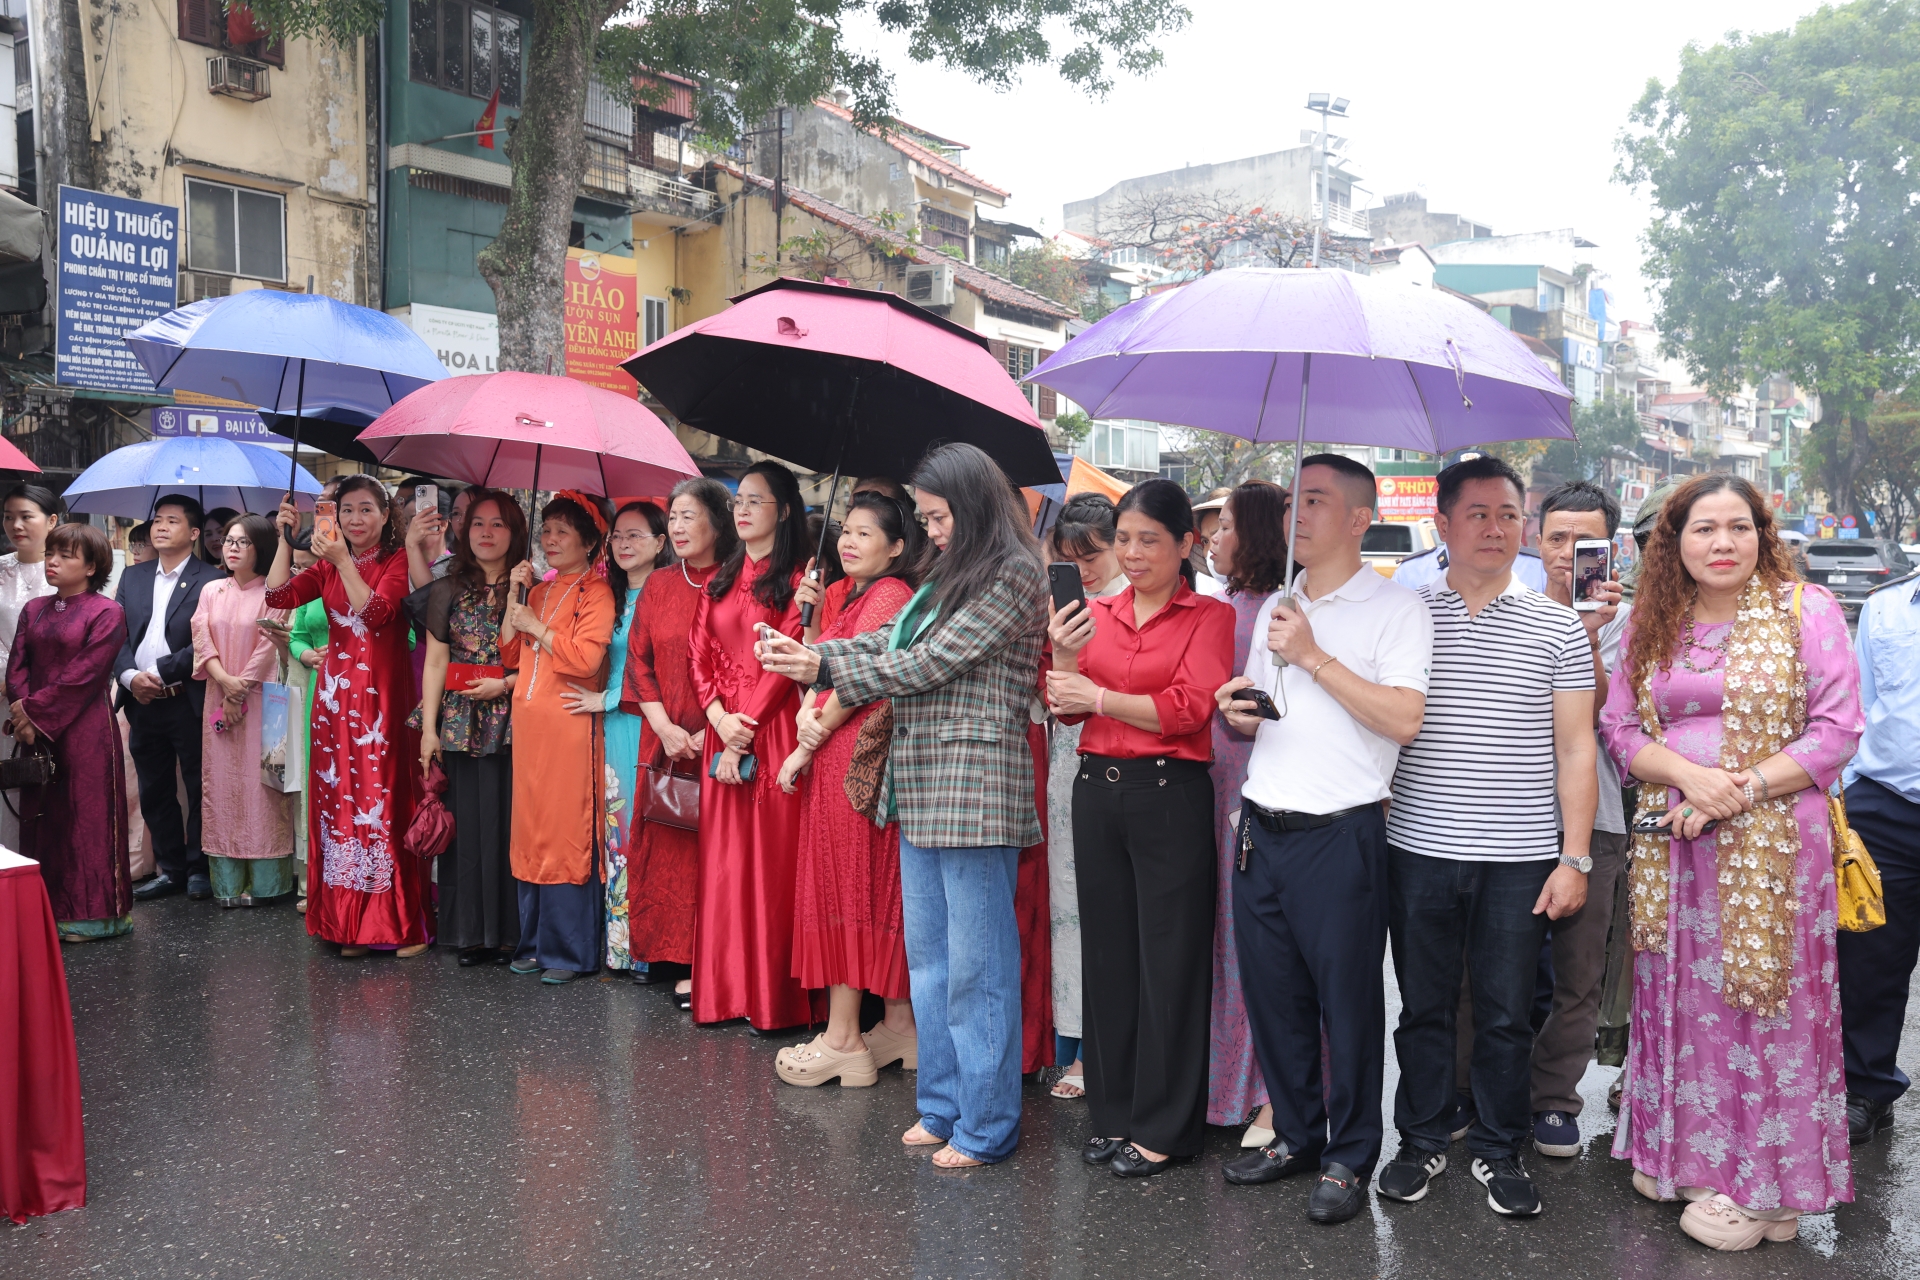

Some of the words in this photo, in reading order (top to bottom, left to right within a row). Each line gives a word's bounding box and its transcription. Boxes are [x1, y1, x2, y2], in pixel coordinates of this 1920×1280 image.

[65, 201, 109, 231] HIỆU
[115, 211, 174, 241] THUỐC
[71, 232, 136, 264] QUẢNG
[141, 245, 169, 272] LỢI
[64, 262, 87, 276] PHONG
[108, 268, 118, 282] TRỊ
[120, 270, 124, 280] Y
[125, 271, 139, 284] HỌC
[64, 288, 88, 298] LƯƠNG
[95, 291, 107, 300] GIA
[142, 298, 154, 306] DUY
[155, 300, 171, 308] NINH
[101, 284, 115, 293] CHỦ
[65, 308, 80, 319] VIÊM
[116, 316, 129, 326] MỤN
[129, 317, 143, 328] NHỌT
[93, 302, 102, 311] TRỊ
[145, 309, 159, 317] GAN
[566, 305, 594, 320] ƯỜN
[598, 311, 621, 325] SỤN
[68, 334, 84, 343] CÁC
[85, 336, 102, 345] BỆNH
[564, 320, 599, 345] YỀN
[603, 329, 637, 350] ANH
[437, 348, 480, 371] HOA
[568, 343, 586, 355] ĐÊM
[587, 345, 609, 358] ĐỒNG
[610, 348, 630, 360] XUÂN
[1577, 343, 1597, 369] ACB
[225, 419, 242, 436] ĐẠI
[244, 418, 258, 434] LÝ
[1398, 478, 1435, 494] THỦY
